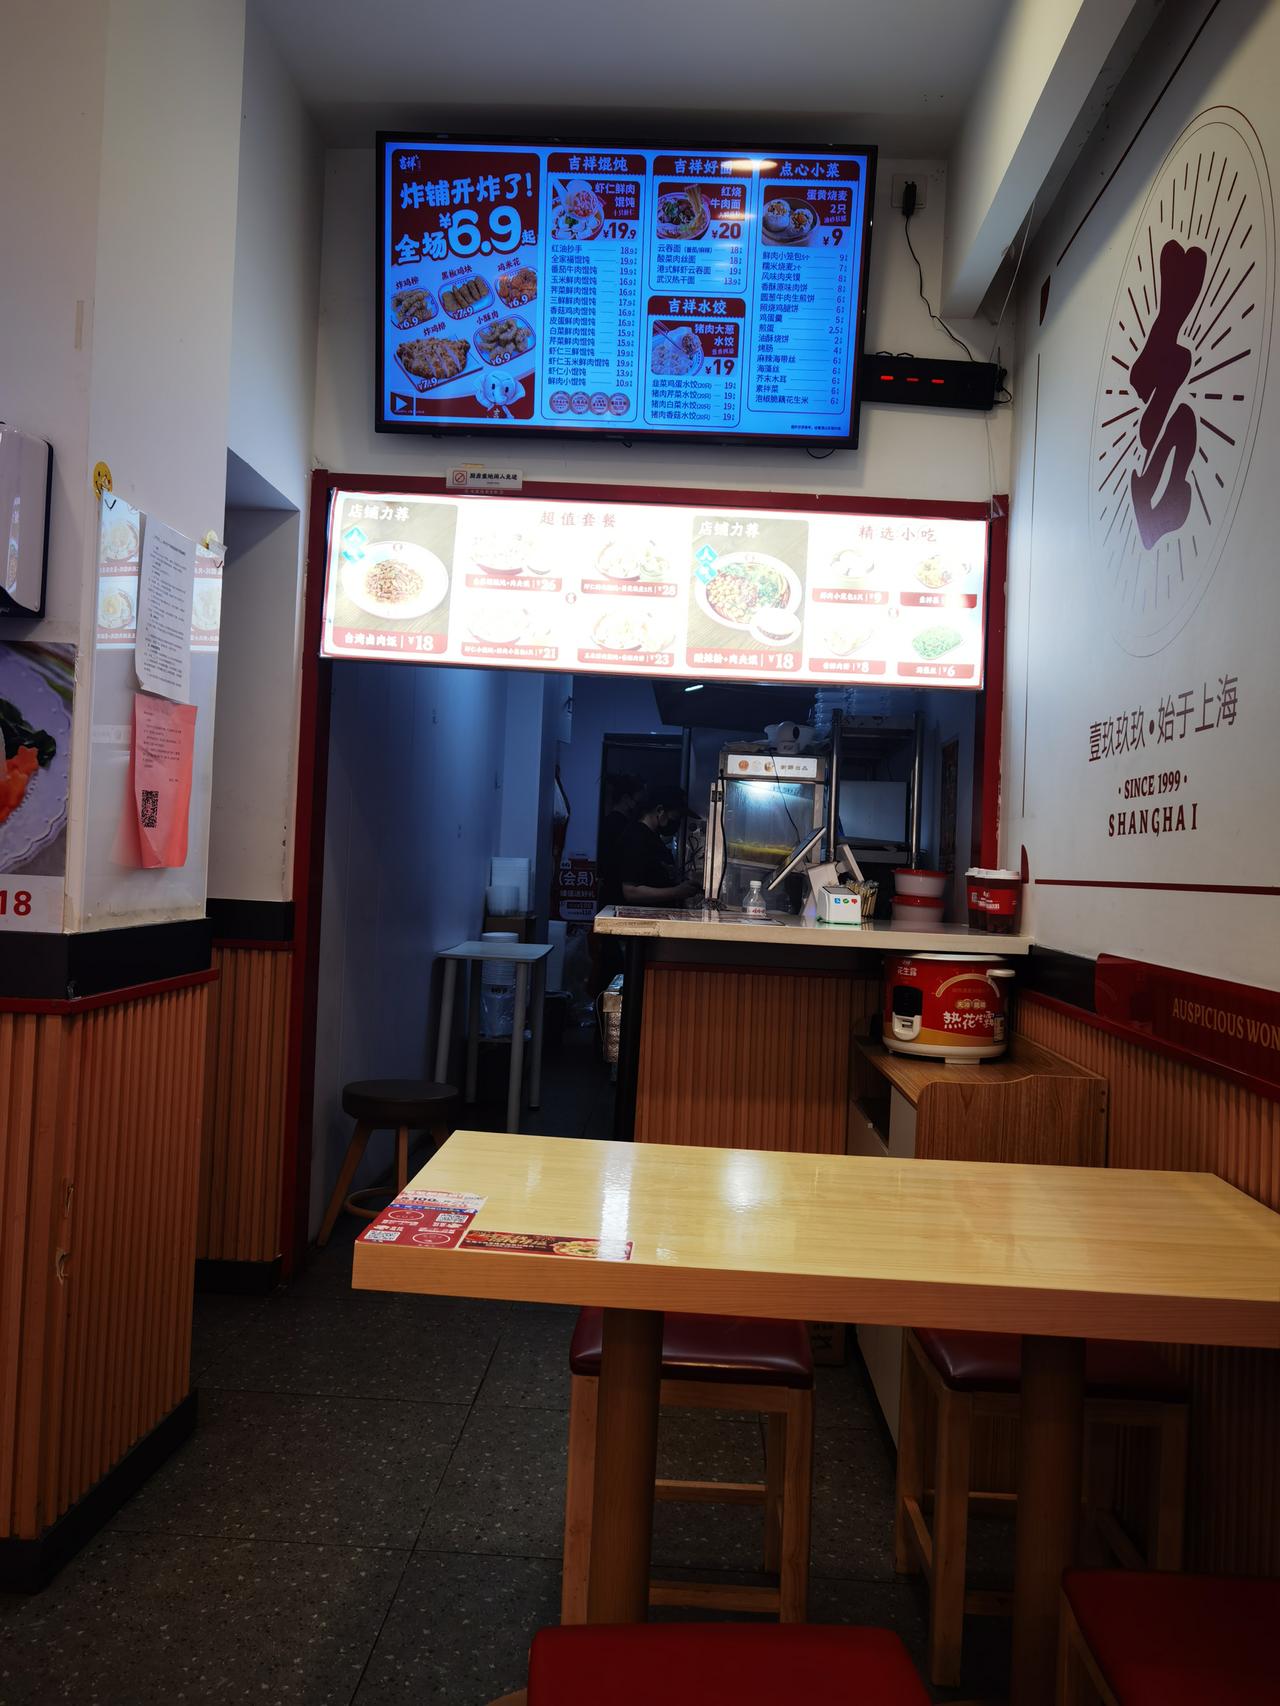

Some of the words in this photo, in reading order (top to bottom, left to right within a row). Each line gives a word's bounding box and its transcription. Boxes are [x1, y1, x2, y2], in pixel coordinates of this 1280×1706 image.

[780, 161, 840, 178] 点心小菜
[595, 183, 635, 194] 虾仁鲜肉
[721, 186, 742, 197] 红烧
[806, 189, 848, 201] 蛋黄烧麦
[614, 196, 635, 208] 馄饨
[710, 198, 741, 209] 牛肉面
[830, 204, 846, 214] 2只
[603, 222, 636, 239] ¥19.9
[712, 222, 741, 239] ¥20
[823, 228, 843, 246] ¥9
[395, 231, 447, 264] 全场
[551, 244, 583, 254] 红油抄手
[657, 244, 681, 253] 云吞面
[551, 255, 590, 264] 全家福馄饨
[657, 254, 696, 264] 酸菜肉丝面
[498, 257, 521, 272] 鸡米花
[551, 264, 597, 274] 番茄牛肉馄饨
[657, 264, 711, 274] 港式鲜虾云吞面
[441, 264, 472, 281] 黑椒鸡块
[762, 272, 800, 281] 风味肉夹馍
[551, 276, 597, 286] 玉米鲜肉馄饨
[656, 276, 695, 284] 武汉热干面
[762, 283, 808, 292] 香酥原味肉饼
[550, 296, 596, 306] 三鲜鲜肉馄饨
[550, 306, 596, 316] 香菇鸡肉馄饨
[668, 298, 727, 315] 吉祥水饺
[476, 310, 499, 325] 小酥肉
[550, 316, 596, 326] 皮蛋鲜肉馄饨
[550, 327, 595, 336] 白菜鲜肉馄饨
[694, 324, 734, 334] 猪肉大葱
[759, 324, 774, 332] 煎蛋
[549, 336, 595, 346] 芹菜鲜肉馄饨
[714, 337, 734, 346] 水饺
[759, 334, 789, 343] 油酥烧饼
[549, 348, 594, 356] 虾仁三鲜馄饨
[758, 344, 774, 352] 烤肠
[549, 358, 609, 367] 虾仁玉米鲜肉馄饨
[757, 354, 796, 364] 麻辣海带丝
[548, 367, 586, 376] 虾仁小馄饨
[705, 359, 735, 376] ¥19
[548, 377, 586, 386] 鲜肉小馄饨
[756, 375, 786, 383] 芥末木耳
[756, 385, 778, 393] 素拌菜
[539, 511, 617, 529] 超值套餐
[858, 525, 937, 542] 精选小吃
[407, 634, 434, 651] ¥18
[768, 653, 794, 670] ¥18
[1124, 775, 1155, 800] SINCE
[1158, 770, 1181, 794] 1999
[1108, 803, 1198, 837] SHANGHAI
[1172, 997, 1244, 1039] AUSPICIOUS
